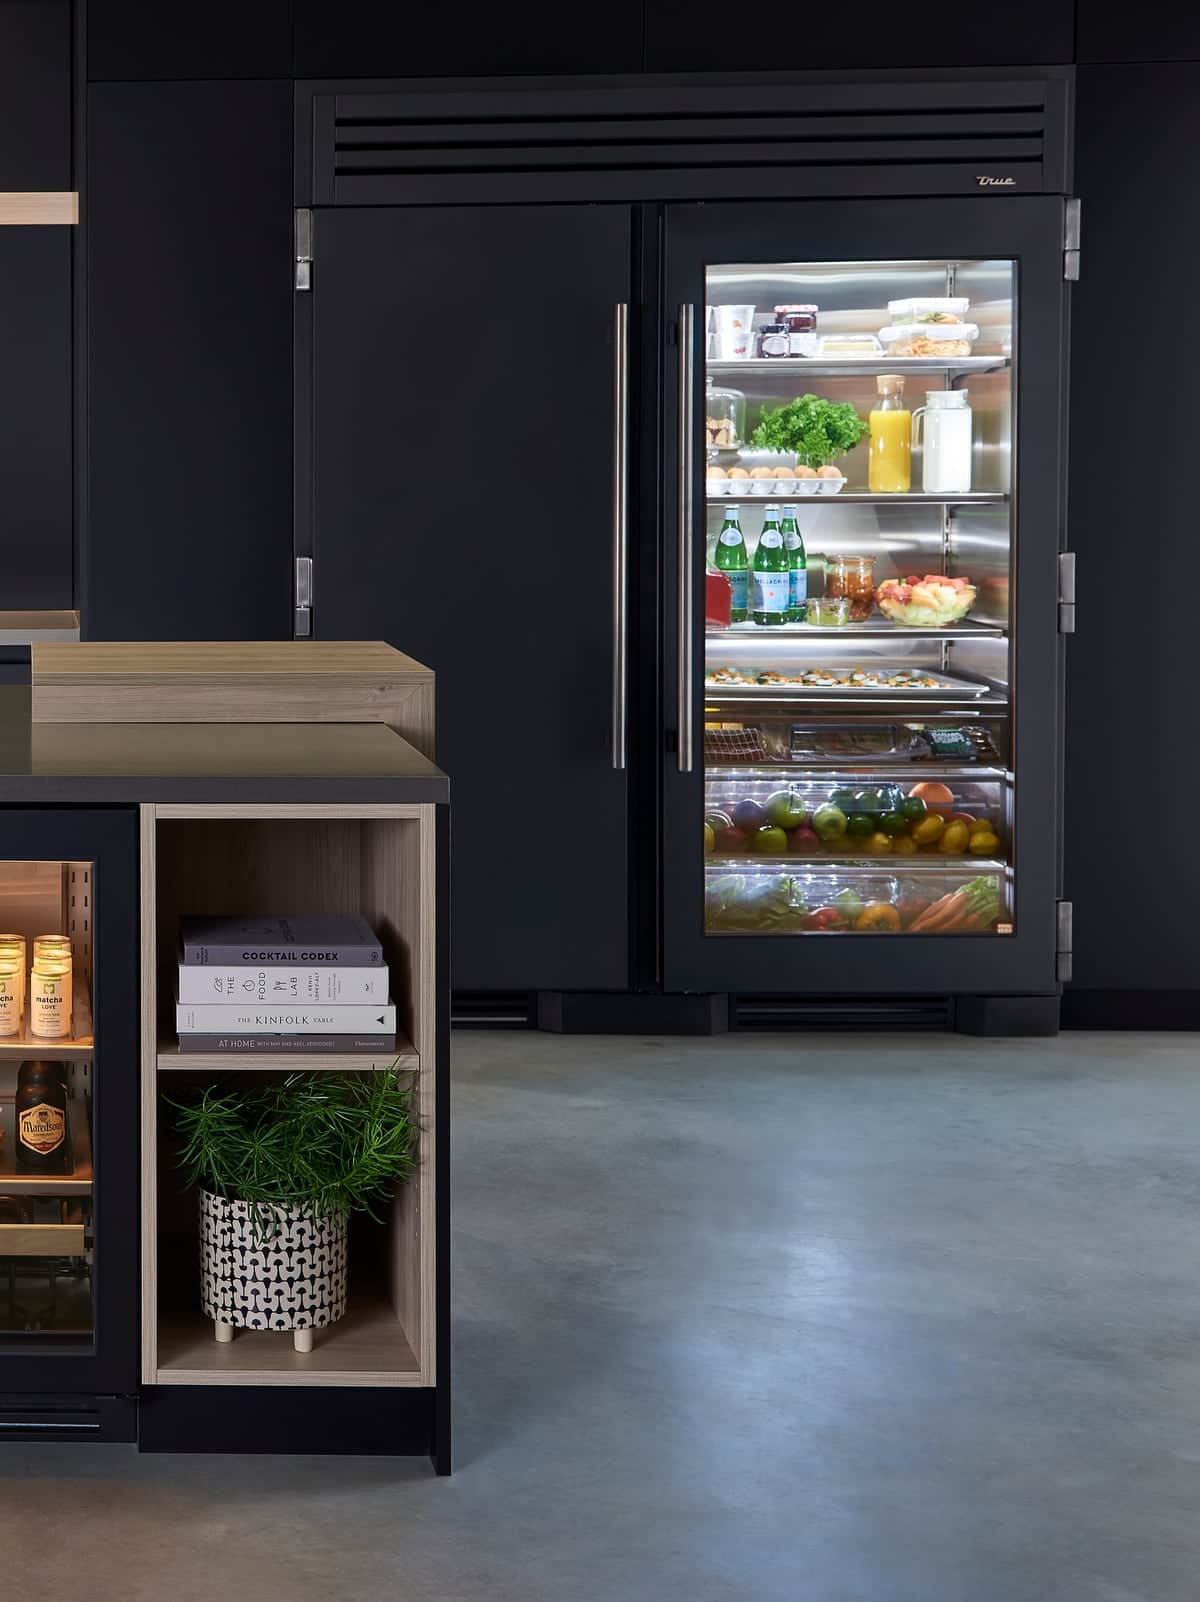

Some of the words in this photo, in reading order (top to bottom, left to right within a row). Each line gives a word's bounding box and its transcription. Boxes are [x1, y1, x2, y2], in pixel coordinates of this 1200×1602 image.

[242, 952, 297, 961] COCKTAIL
[301, 952, 338, 961] CODEX
[227, 976, 235, 995] THE
[258, 972, 266, 1000] FOOD
[290, 977, 298, 998] LAB
[255, 1016, 309, 1025] KINFOLK
[218, 1040, 228, 1048] AT
[231, 1040, 255, 1048] HOME
